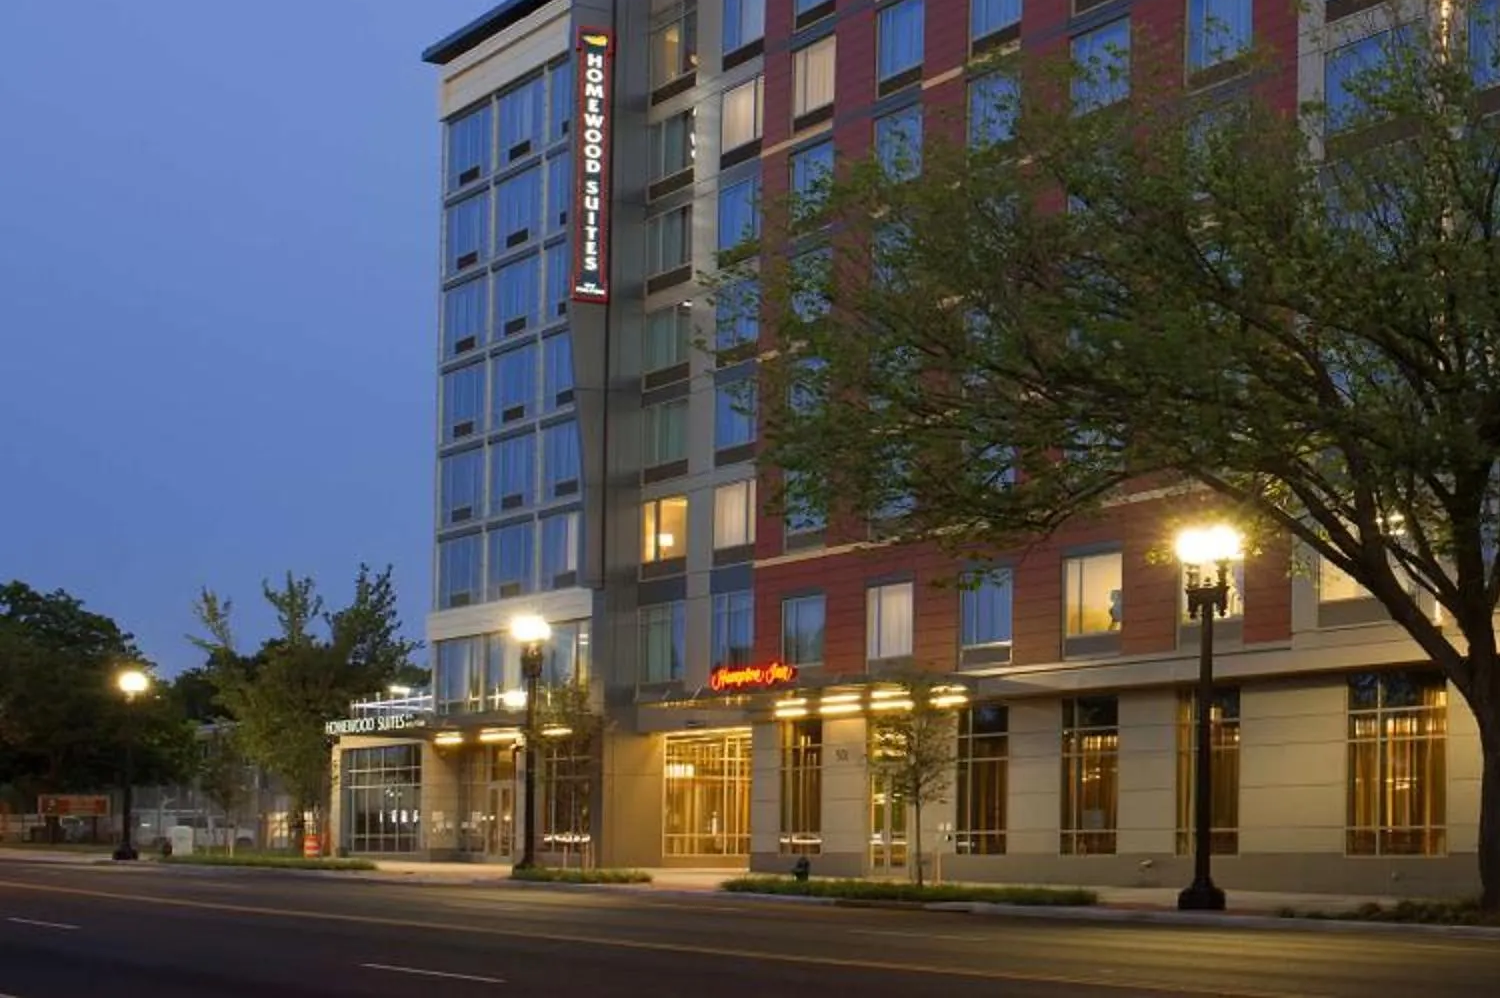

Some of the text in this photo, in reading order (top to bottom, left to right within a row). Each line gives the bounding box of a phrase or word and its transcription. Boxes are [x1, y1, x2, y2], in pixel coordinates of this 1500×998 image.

[585, 53, 604, 174] HOMEWOOD
[583, 180, 600, 271] SUITES
[325, 717, 375, 735] HOMEWOOD
[377, 713, 405, 731] SUITES
